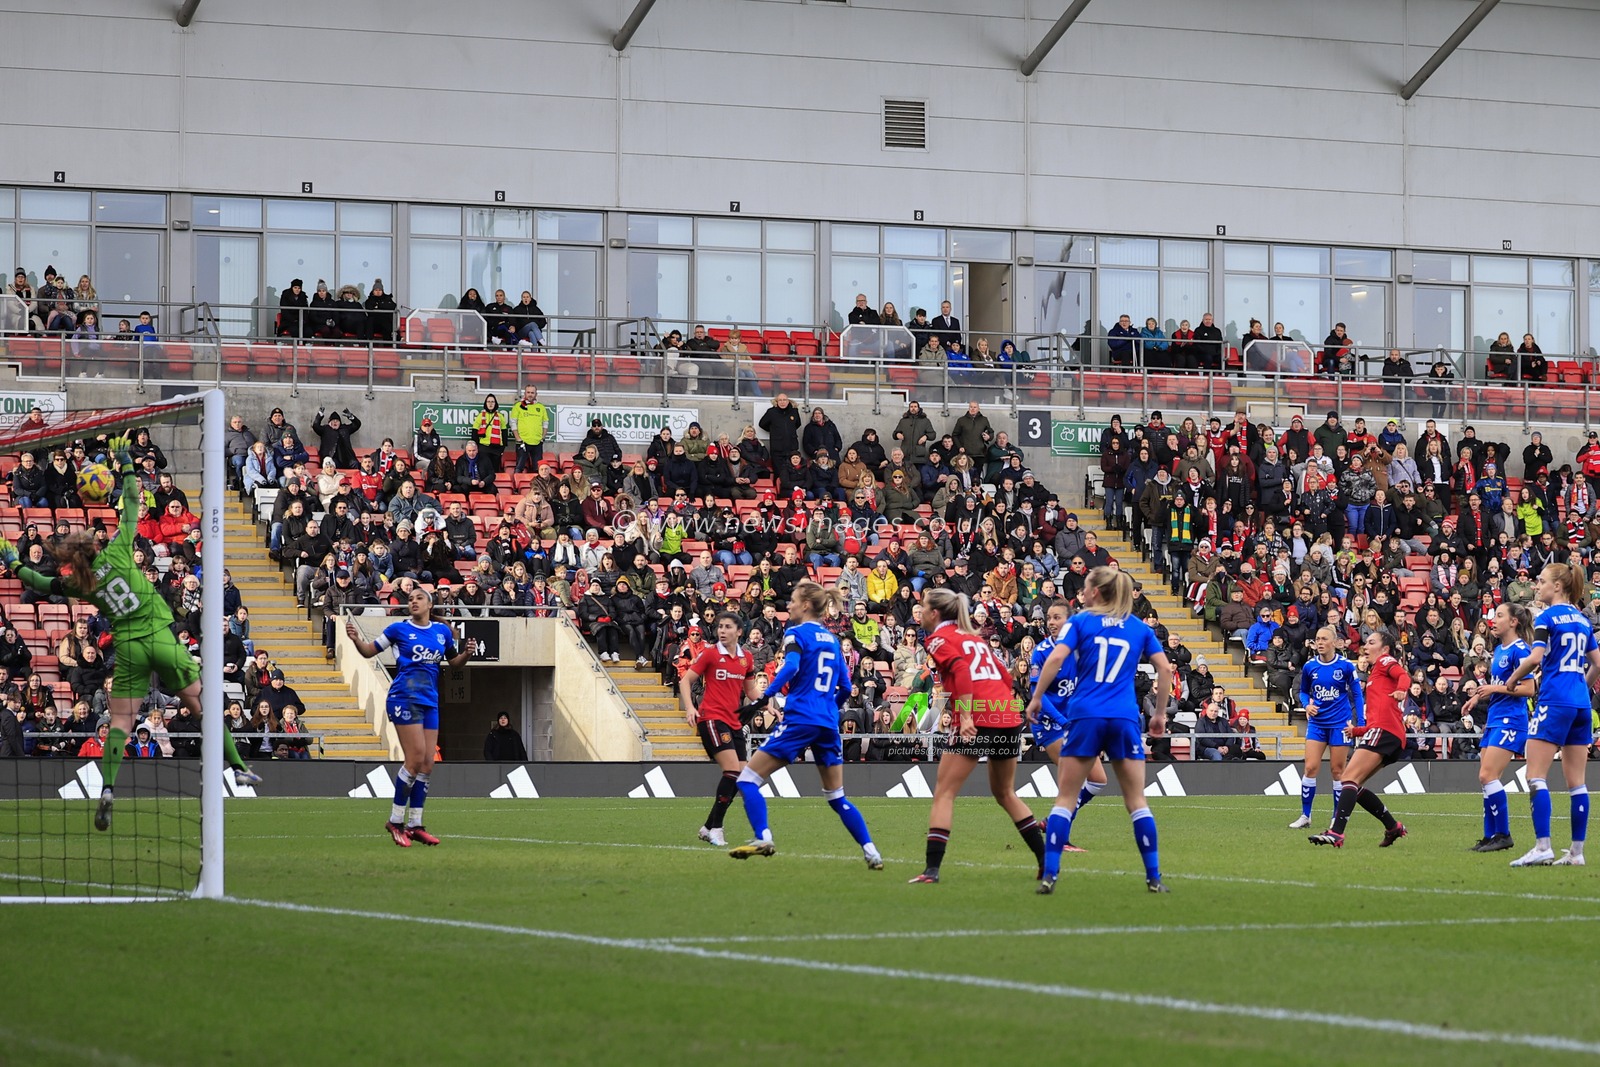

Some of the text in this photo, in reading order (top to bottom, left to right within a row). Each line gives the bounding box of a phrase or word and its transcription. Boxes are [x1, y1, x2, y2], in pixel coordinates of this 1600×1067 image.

[56, 172, 63, 182] 4
[304, 183, 310, 192] 5
[497, 192, 503, 201] 6
[732, 202, 738, 211] 7
[916, 211, 922, 220] 8
[1218, 226, 1224, 235] 9
[1503, 241, 1511, 250] 10
[586, 412, 670, 430] KINGSTONE
[1028, 418, 1042, 439] 3
[456, 428, 473, 436] PRE
[211, 508, 220, 533] PRO
[96, 577, 140, 616] 18
[961, 640, 1003, 682] 23
[1094, 636, 1130, 684] 17
[1559, 632, 1588, 674] 28
[814, 651, 836, 693] 5
[1314, 684, 1340, 699] Stake
[1499, 729, 1510, 746] 7
